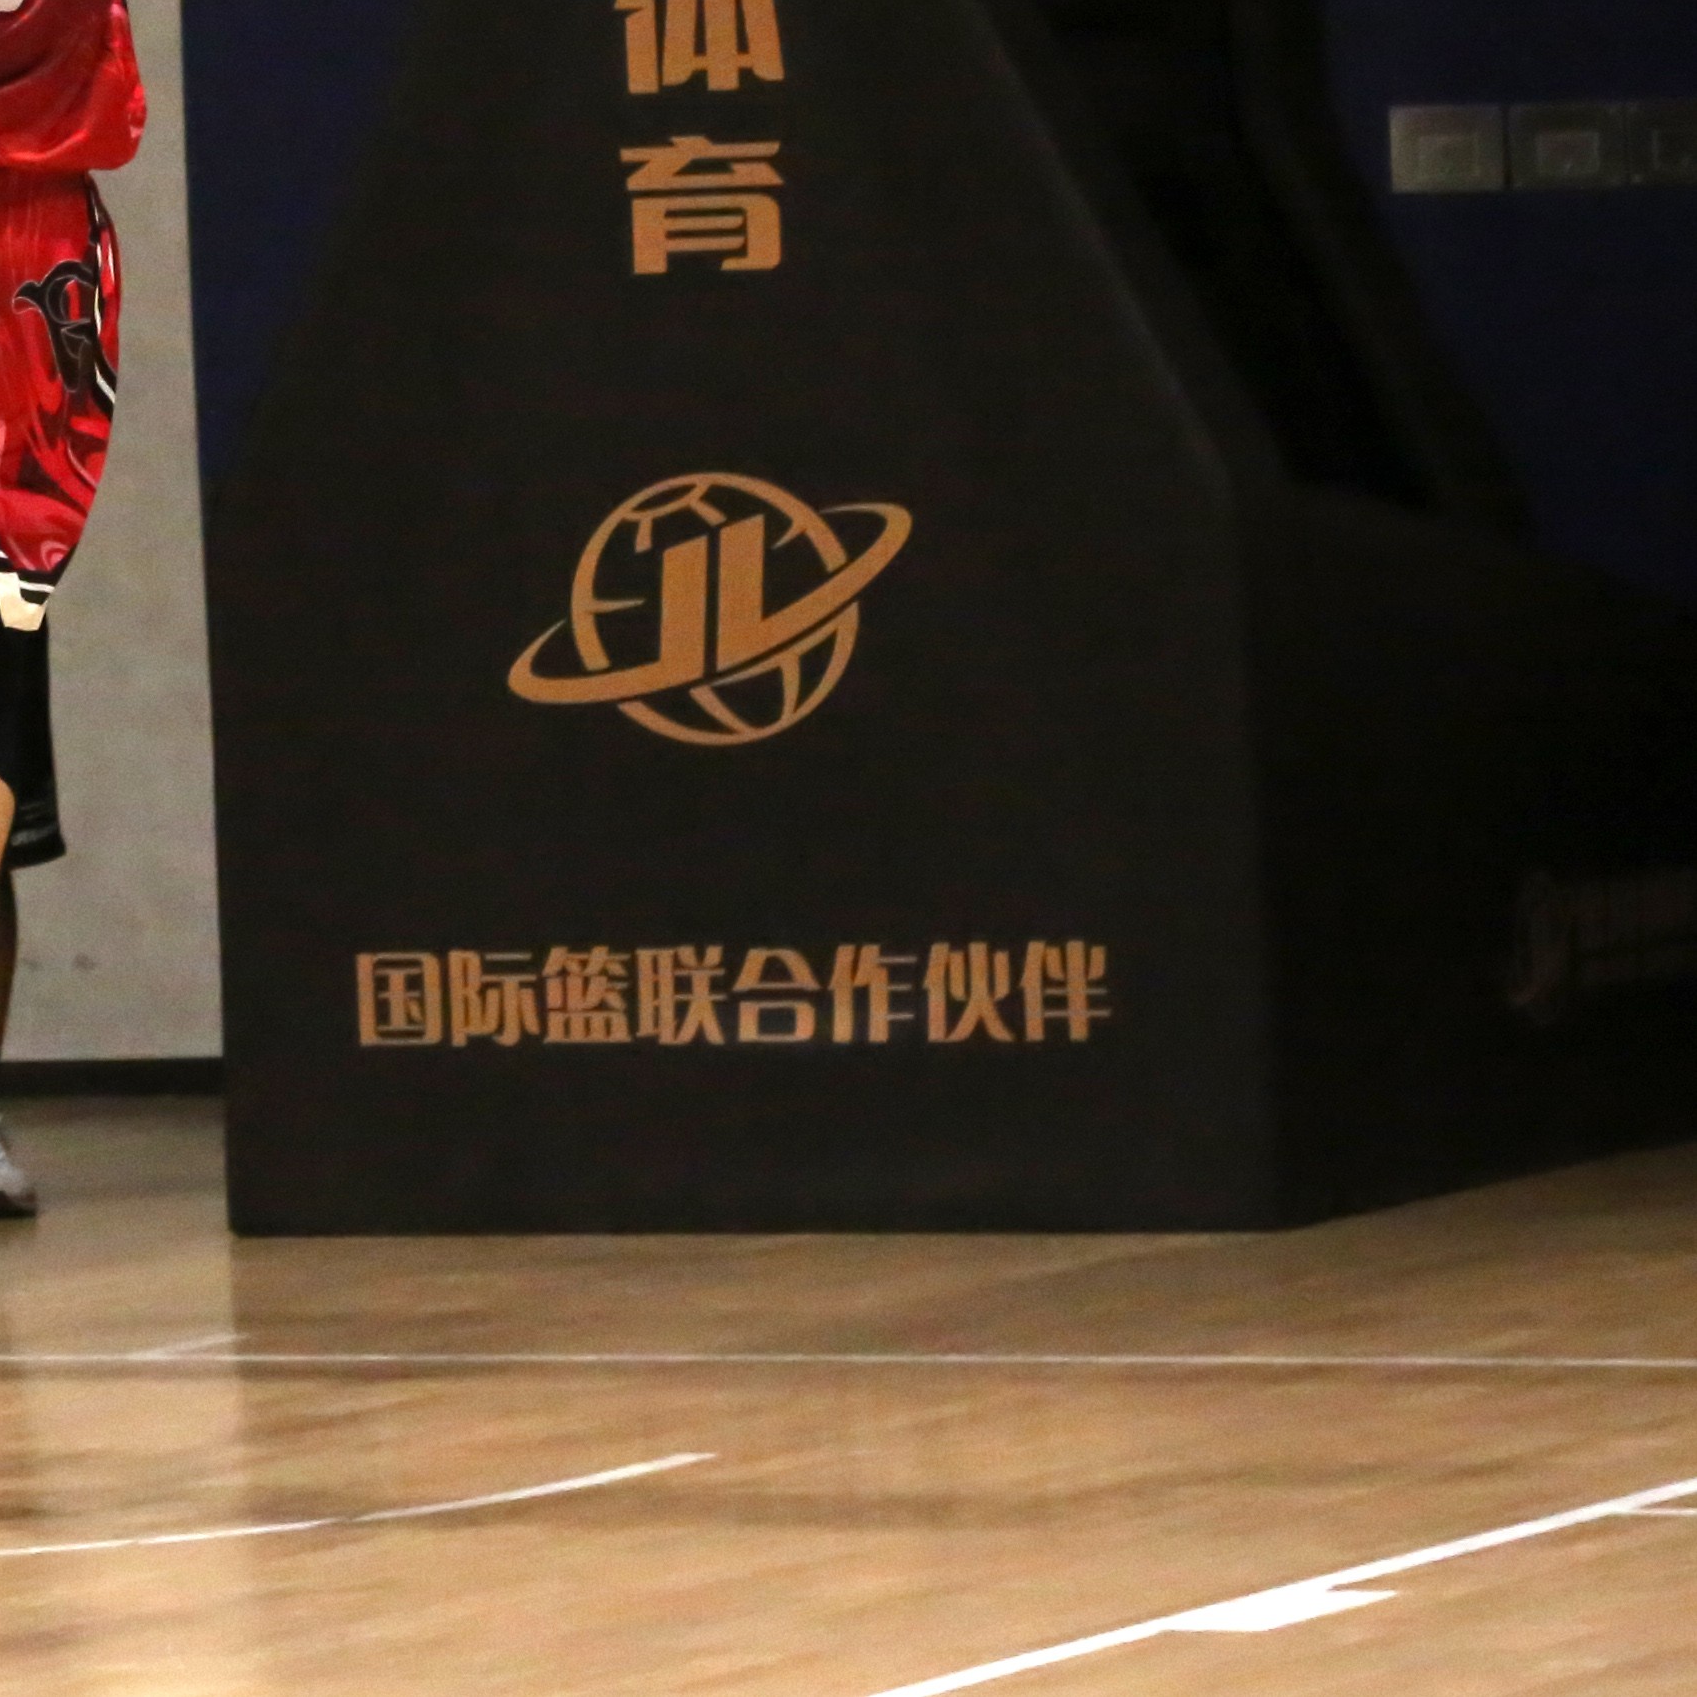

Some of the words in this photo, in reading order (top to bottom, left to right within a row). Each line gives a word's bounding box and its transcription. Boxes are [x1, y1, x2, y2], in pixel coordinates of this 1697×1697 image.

[355, 940, 1112, 1047] 国际篮联合作伙伴
